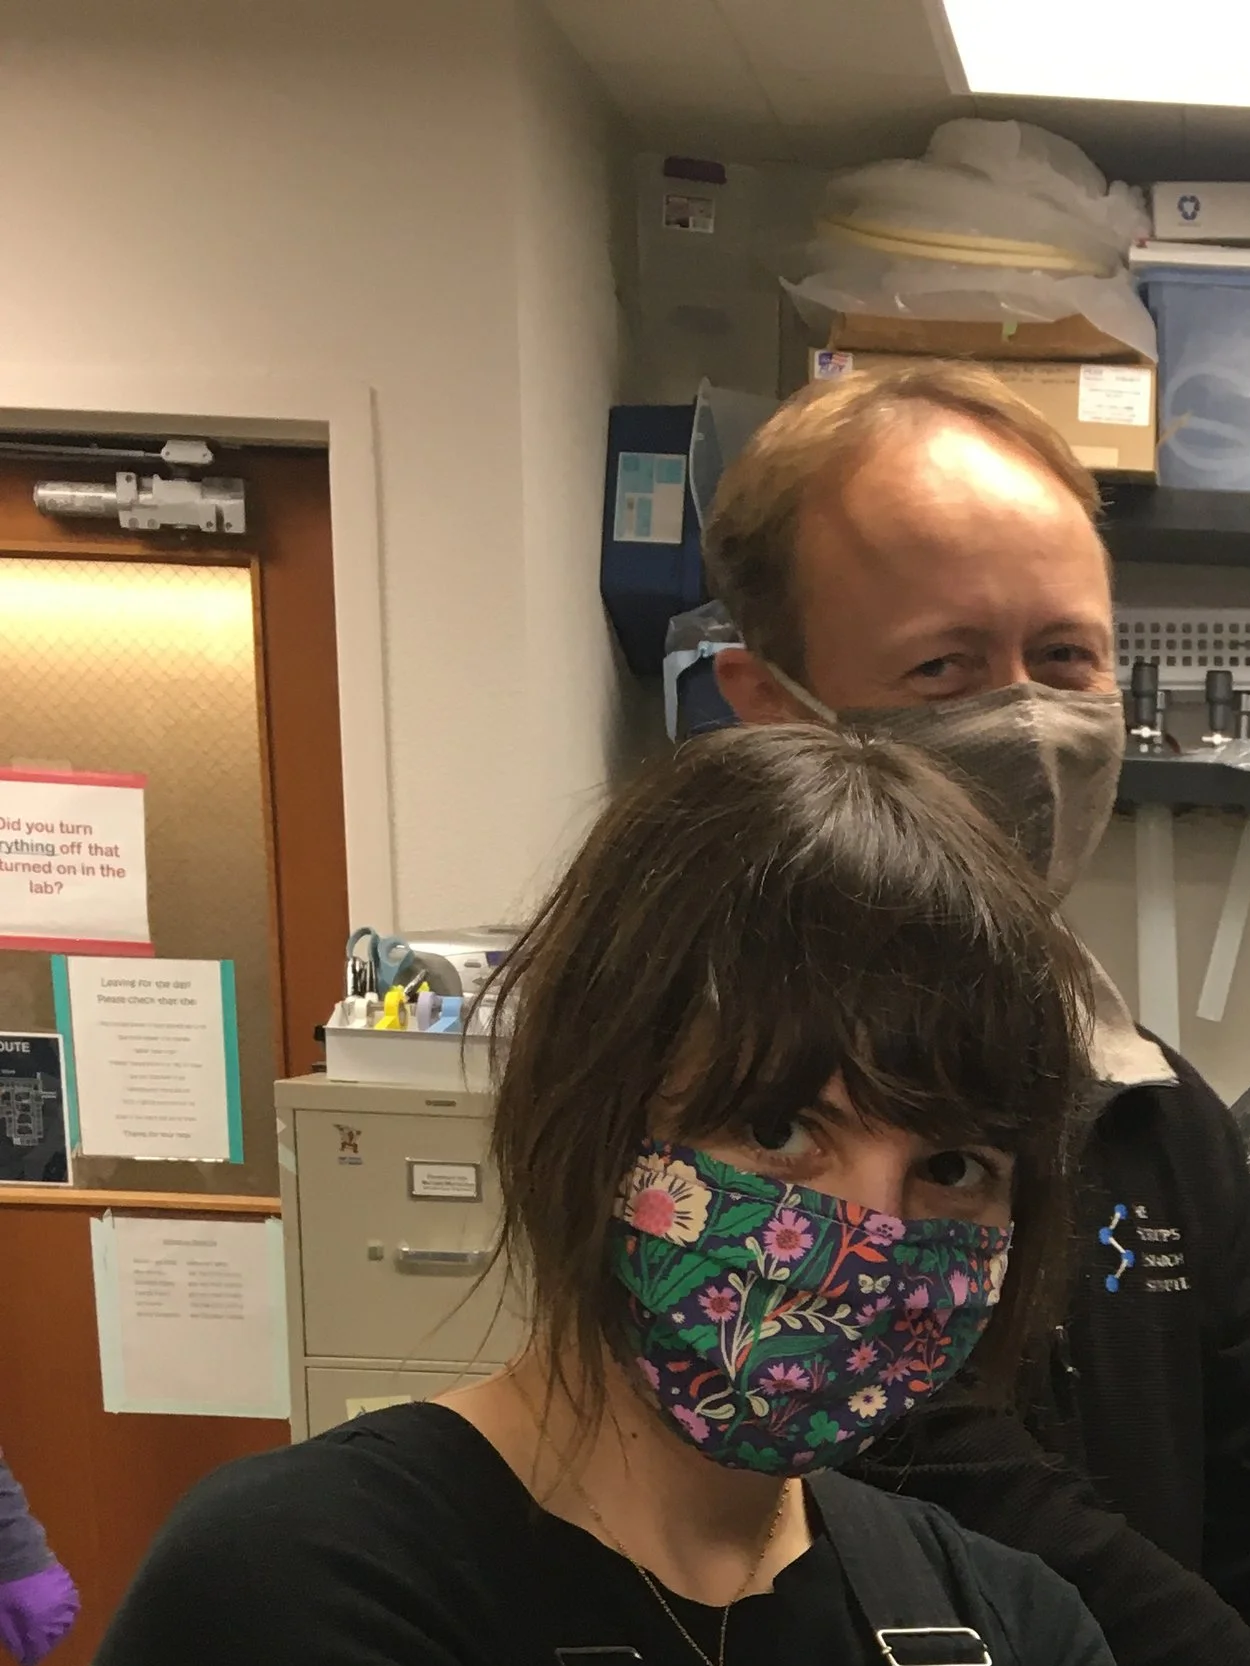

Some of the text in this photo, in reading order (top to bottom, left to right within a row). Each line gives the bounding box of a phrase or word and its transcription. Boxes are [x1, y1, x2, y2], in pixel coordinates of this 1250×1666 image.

[26, 822, 54, 835] you
[59, 820, 93, 835] turn
[60, 842, 82, 855] off
[88, 843, 120, 858] that
[56, 864, 76, 875] on
[82, 863, 95, 876] in
[100, 864, 126, 878] the
[29, 880, 63, 894] lab?
